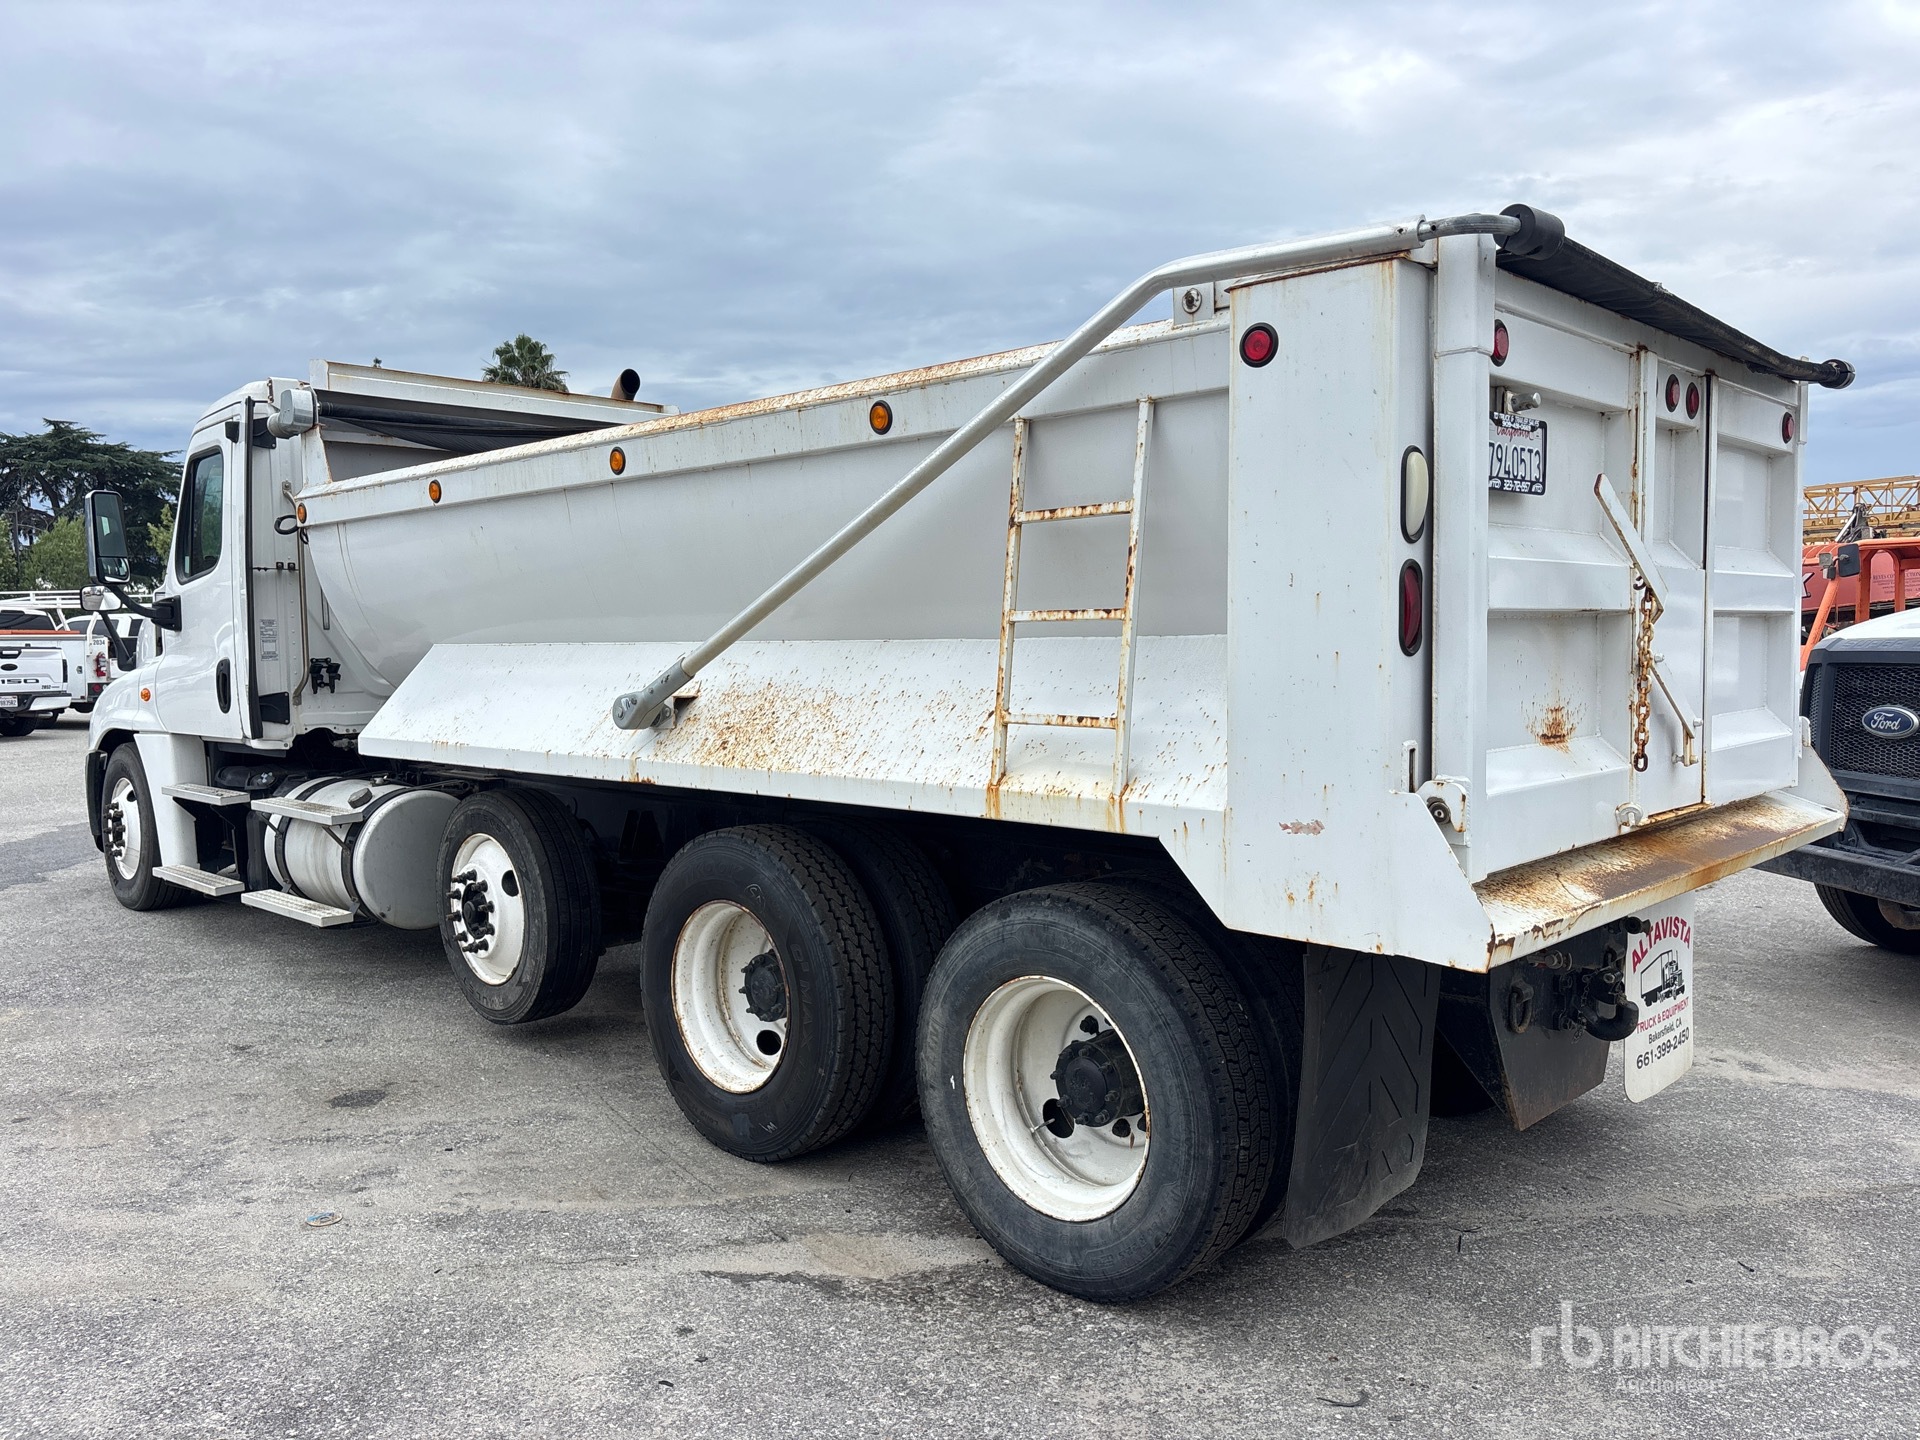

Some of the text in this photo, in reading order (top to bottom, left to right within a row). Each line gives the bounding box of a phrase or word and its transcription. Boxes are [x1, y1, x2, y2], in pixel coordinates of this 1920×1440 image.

[1489, 442, 1541, 482] 79405T3
[1870, 712, 1901, 731] Ford
[1632, 915, 1691, 974] ALTAVISTA
[1636, 996, 1690, 1034] TRUCK & EQUIPMENT
[1648, 1017, 1682, 1045] Bakersfield, CA
[1636, 1026, 1690, 1070] 661-399-2450
